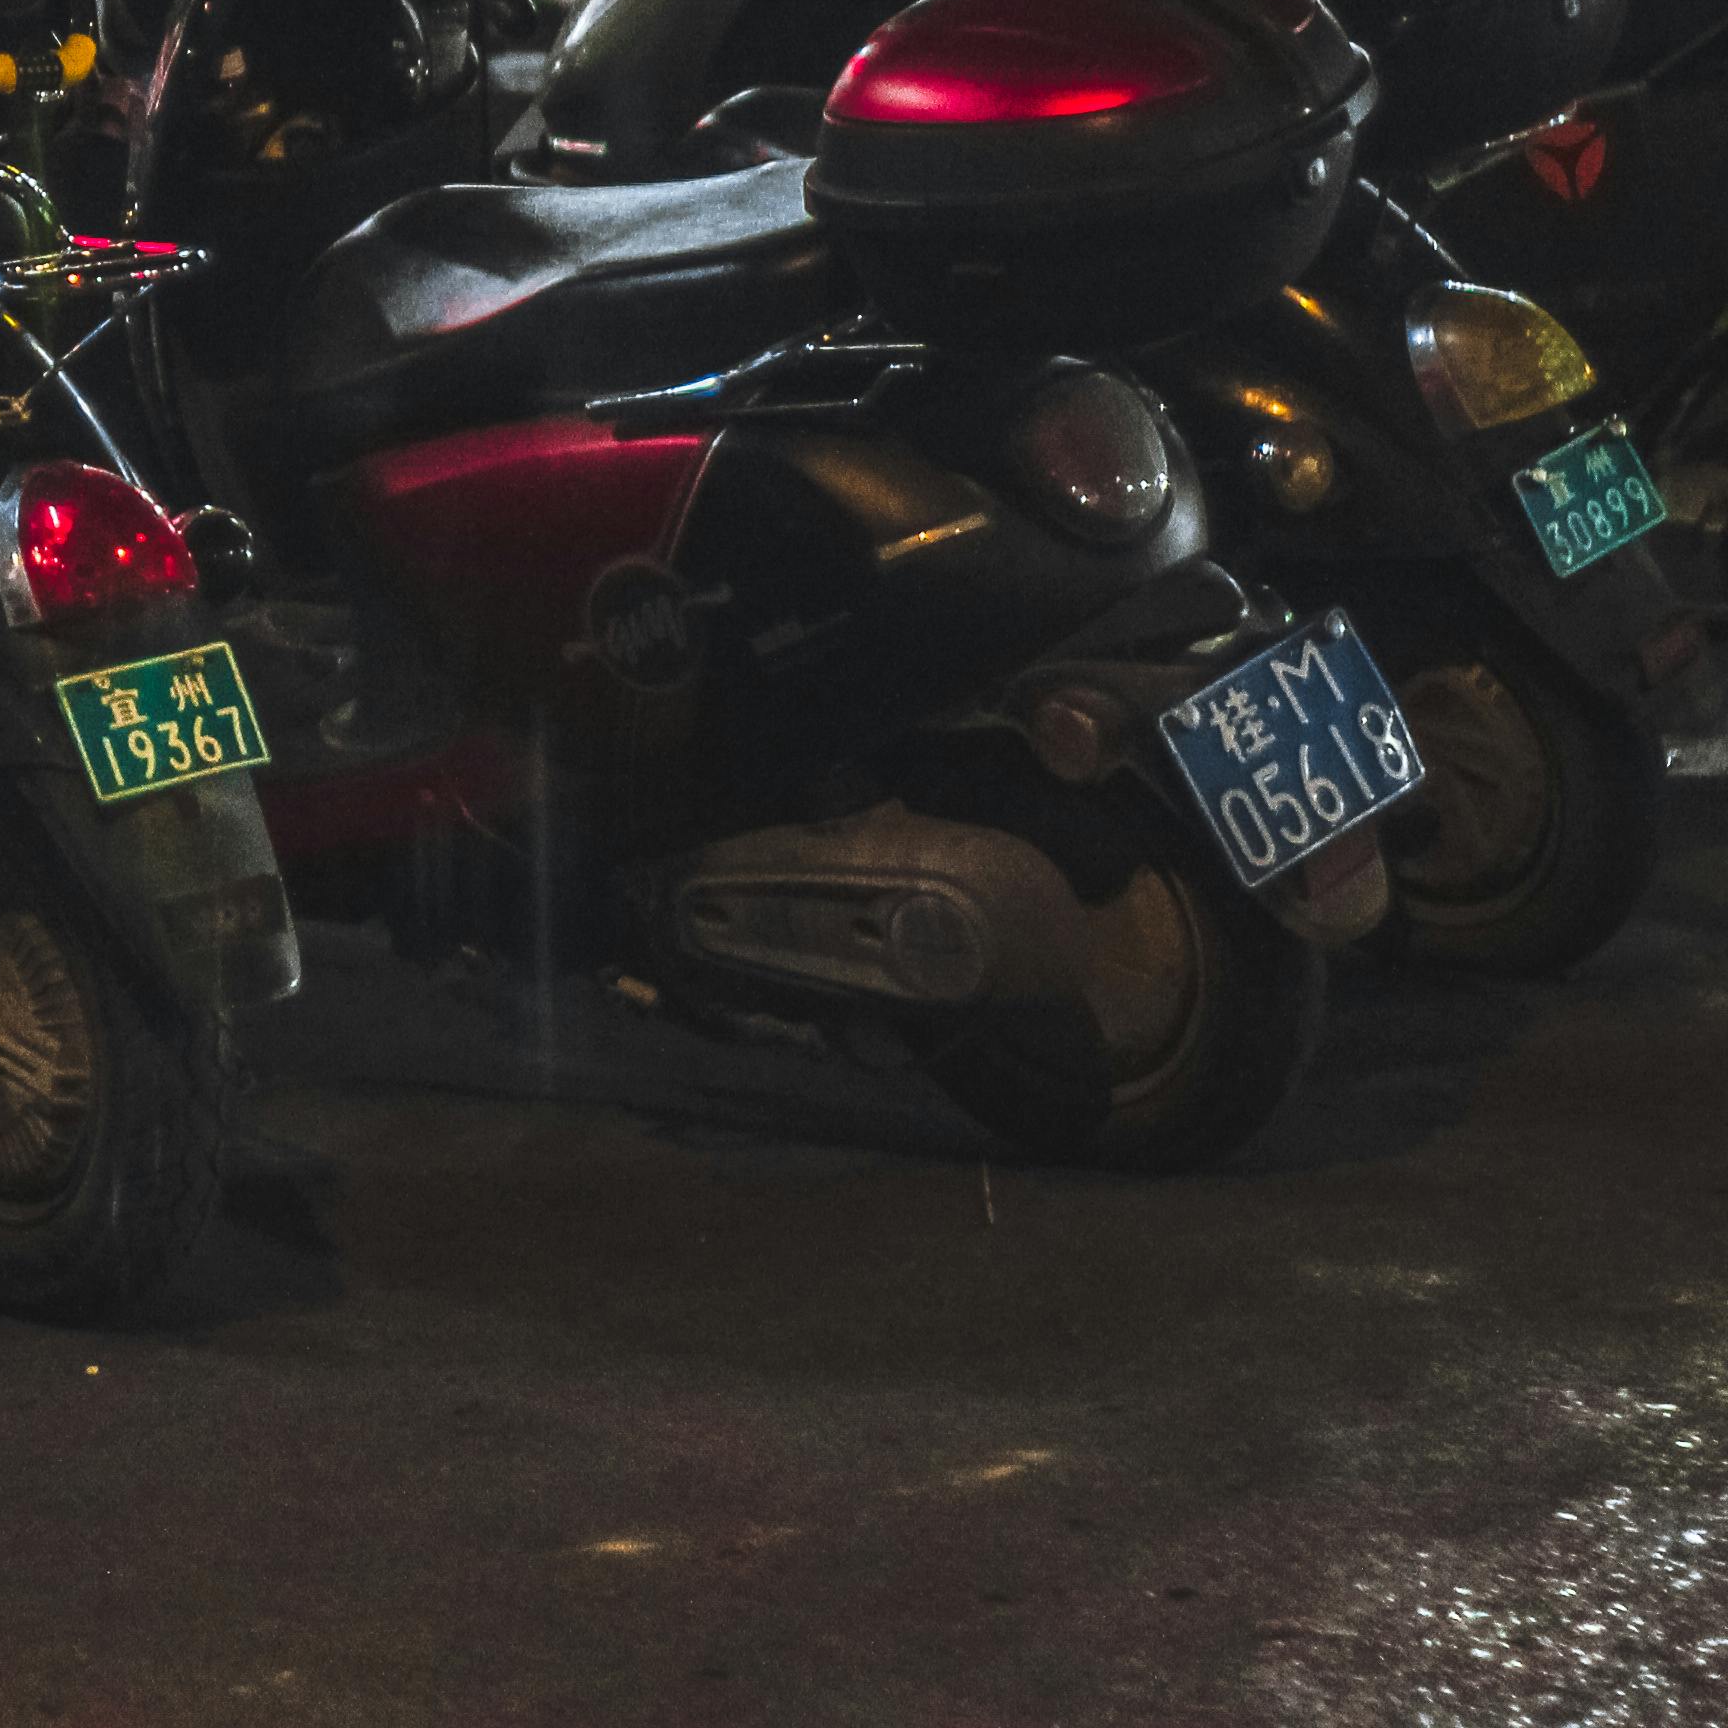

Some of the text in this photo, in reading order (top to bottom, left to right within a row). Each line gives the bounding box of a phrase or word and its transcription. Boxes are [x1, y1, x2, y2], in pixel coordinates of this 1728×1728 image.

[1545, 476, 1650, 566] 30899
[99, 671, 216, 731] 宜州
[101, 705, 250, 787] 19367
[1219, 702, 1411, 866] 05618
